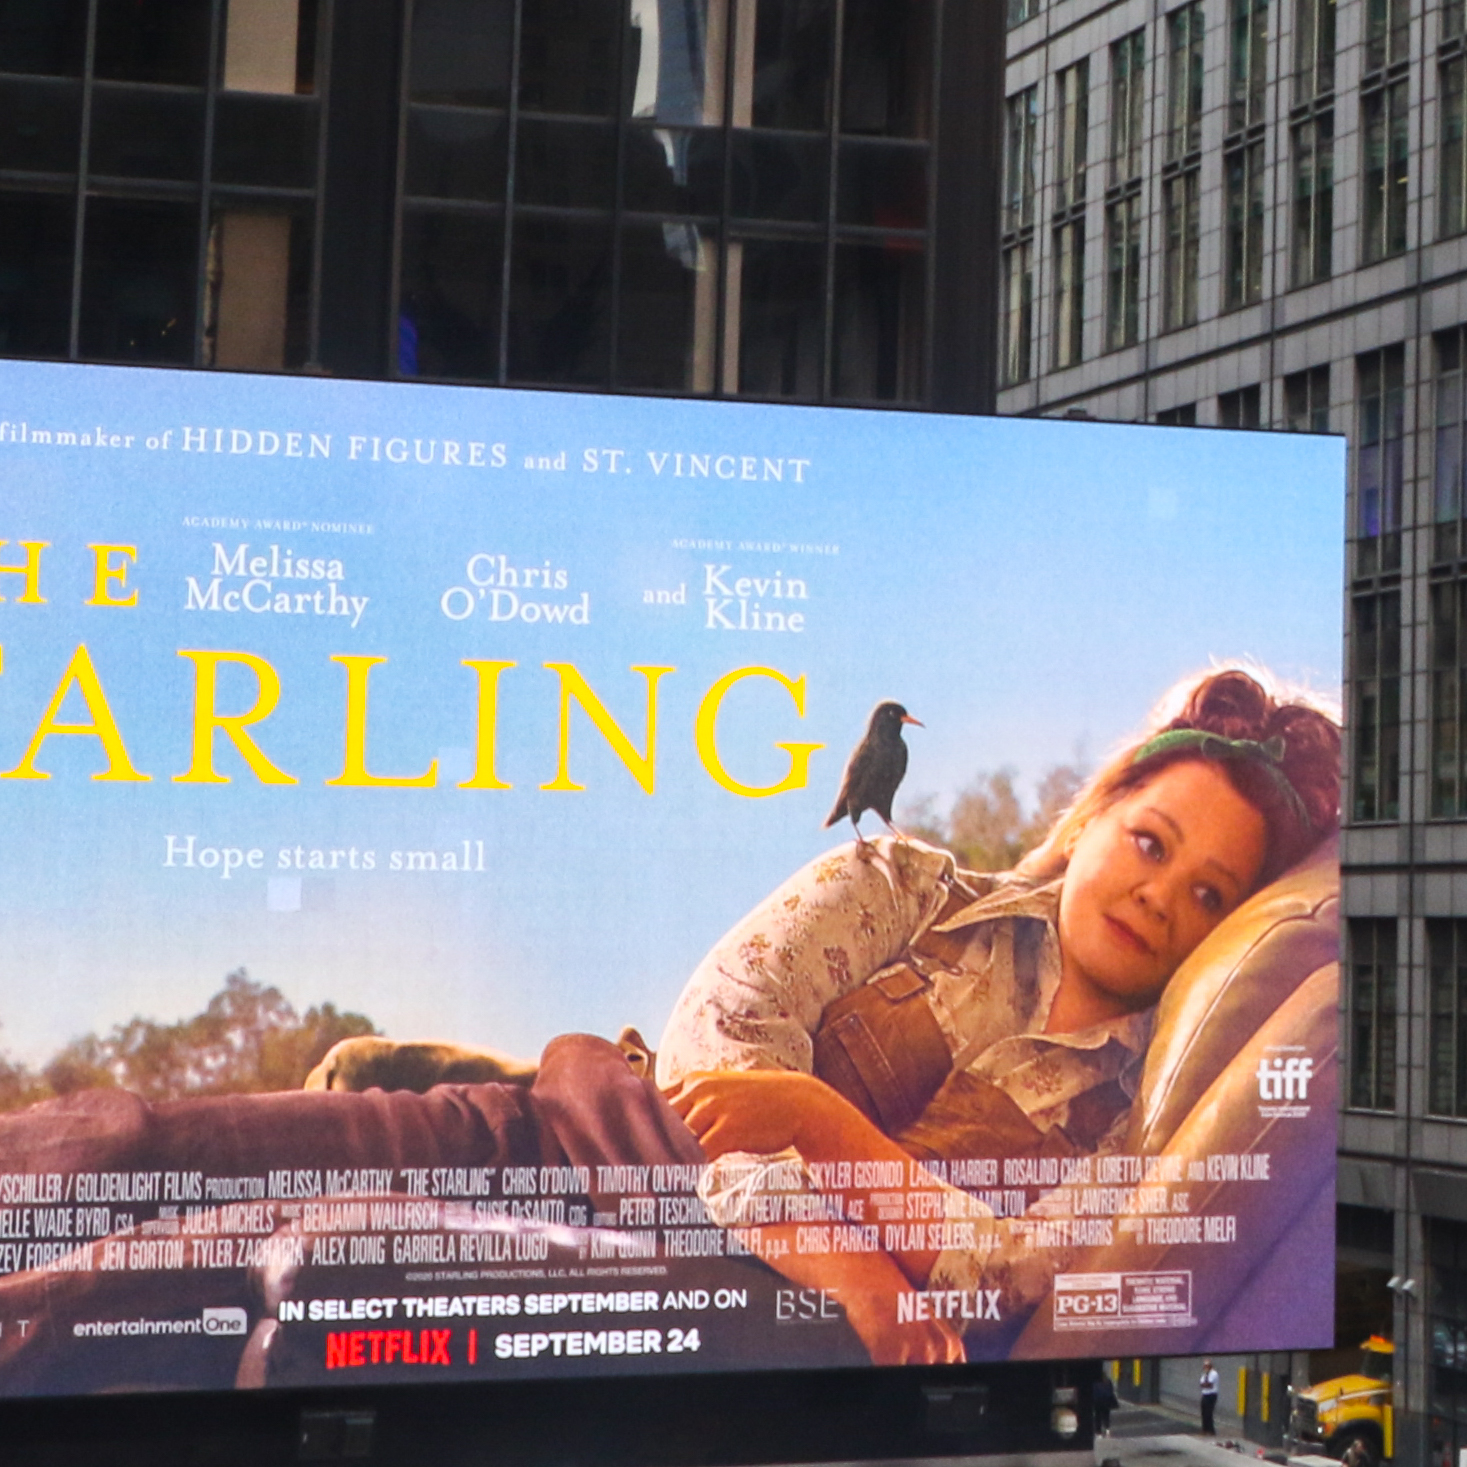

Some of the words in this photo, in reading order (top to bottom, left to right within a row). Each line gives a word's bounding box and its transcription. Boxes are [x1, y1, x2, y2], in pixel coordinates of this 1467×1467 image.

[0, 420, 136, 450] filmmaker
[145, 429, 174, 451] of
[181, 426, 334, 460] HIDDEN
[347, 434, 508, 469] FIGURES
[523, 449, 567, 472] and
[582, 447, 632, 475] ST.
[647, 451, 811, 484] VINCENT
[182, 515, 250, 530] ACADEMY
[310, 520, 374, 535] NOMINEE
[210, 541, 345, 581] Melissa
[671, 537, 733, 552] ACADEMY
[789, 542, 841, 556] WINNER
[466, 551, 569, 592] Chris
[703, 562, 809, 600] Kevin
[183, 576, 370, 629] McCarthy
[440, 585, 591, 626] O'Dowd
[642, 581, 688, 607] and
[703, 597, 806, 633] Kline
[162, 834, 265, 880] Hope
[277, 838, 377, 873] starts
[388, 838, 488, 873] small
[1255, 1057, 1314, 1100] tiff
[75, 1171, 161, 1203] GOLDENLIGHT
[164, 1170, 203, 1200] FILMS
[205, 1175, 266, 1200] PRODUCTION
[268, 1169, 322, 1199] MELISSA
[326, 1168, 393, 1198] McCARTHY
[502, 1165, 537, 1195] CHRIS
[540, 1165, 590, 1194] O'DOWD
[596, 1165, 651, 1194] TIMOTHY
[807, 1161, 851, 1190] SKYLER
[853, 1160, 904, 1189] GISONDO
[909, 1159, 947, 1187] LAURA
[950, 1158, 998, 1187] HARRIER
[1004, 1157, 1058, 1186] ROSALIND
[1060, 1156, 1090, 1185] CHAO
[1096, 1155, 1142, 1184] LORETTA
[1206, 1154, 1239, 1181] KEVIN
[1239, 1153, 1271, 1181] KLINE
[33, 1207, 74, 1238] WADE
[114, 1212, 134, 1236] CSA
[181, 1205, 218, 1234] JULIA
[220, 1204, 275, 1234] MICHELS
[303, 1202, 367, 1232] BENJAMIN
[369, 1201, 438, 1231] WALLFISCH
[569, 1204, 588, 1227] CDG
[619, 1197, 656, 1226] PETER
[847, 1199, 864, 1221] ACE
[906, 1191, 967, 1220] STEPHANIE
[968, 1190, 1026, 1218] HAMILTON
[1073, 1187, 1137, 1216] LAWRENCE
[26, 1242, 93, 1272] FOREMAN
[101, 1240, 126, 1270] JEN
[128, 1238, 185, 1270] GORTON
[191, 1238, 233, 1268] TYLER
[311, 1235, 346, 1265] ALEX
[349, 1235, 386, 1265] DONG
[392, 1234, 456, 1264] GABRIELA
[459, 1233, 512, 1262] REVILLA
[515, 1232, 549, 1261] LUGO
[590, 1231, 616, 1260] KIM
[662, 1229, 724, 1258] THEODORE
[795, 1226, 831, 1255] CHRIS
[833, 1224, 879, 1253] PARKER
[884, 1223, 925, 1252] DYLAN
[1036, 1220, 1070, 1247] MATT
[1072, 1218, 1114, 1246] HARRIS
[1146, 1216, 1202, 1245] THEODORE
[1203, 1215, 1237, 1243] MELFI
[434, 1269, 479, 1281] STARLING
[568, 1267, 585, 1278] ALL
[587, 1266, 619, 1277] RIGHTS
[278, 1299, 304, 1322] IN
[307, 1297, 398, 1321] SELECT
[401, 1294, 521, 1320] THEATERS
[523, 1289, 659, 1315] SEPTEMBER
[662, 1289, 710, 1310] AND
[713, 1288, 748, 1309] ON
[775, 1288, 840, 1320] BSE
[896, 1287, 1001, 1324] NETFLIX
[72, 1317, 201, 1338] entertainment
[205, 1316, 242, 1332] One
[325, 1328, 452, 1370] NETFLIX
[494, 1328, 662, 1360] SEPTEMBER
[666, 1327, 701, 1353] 24
